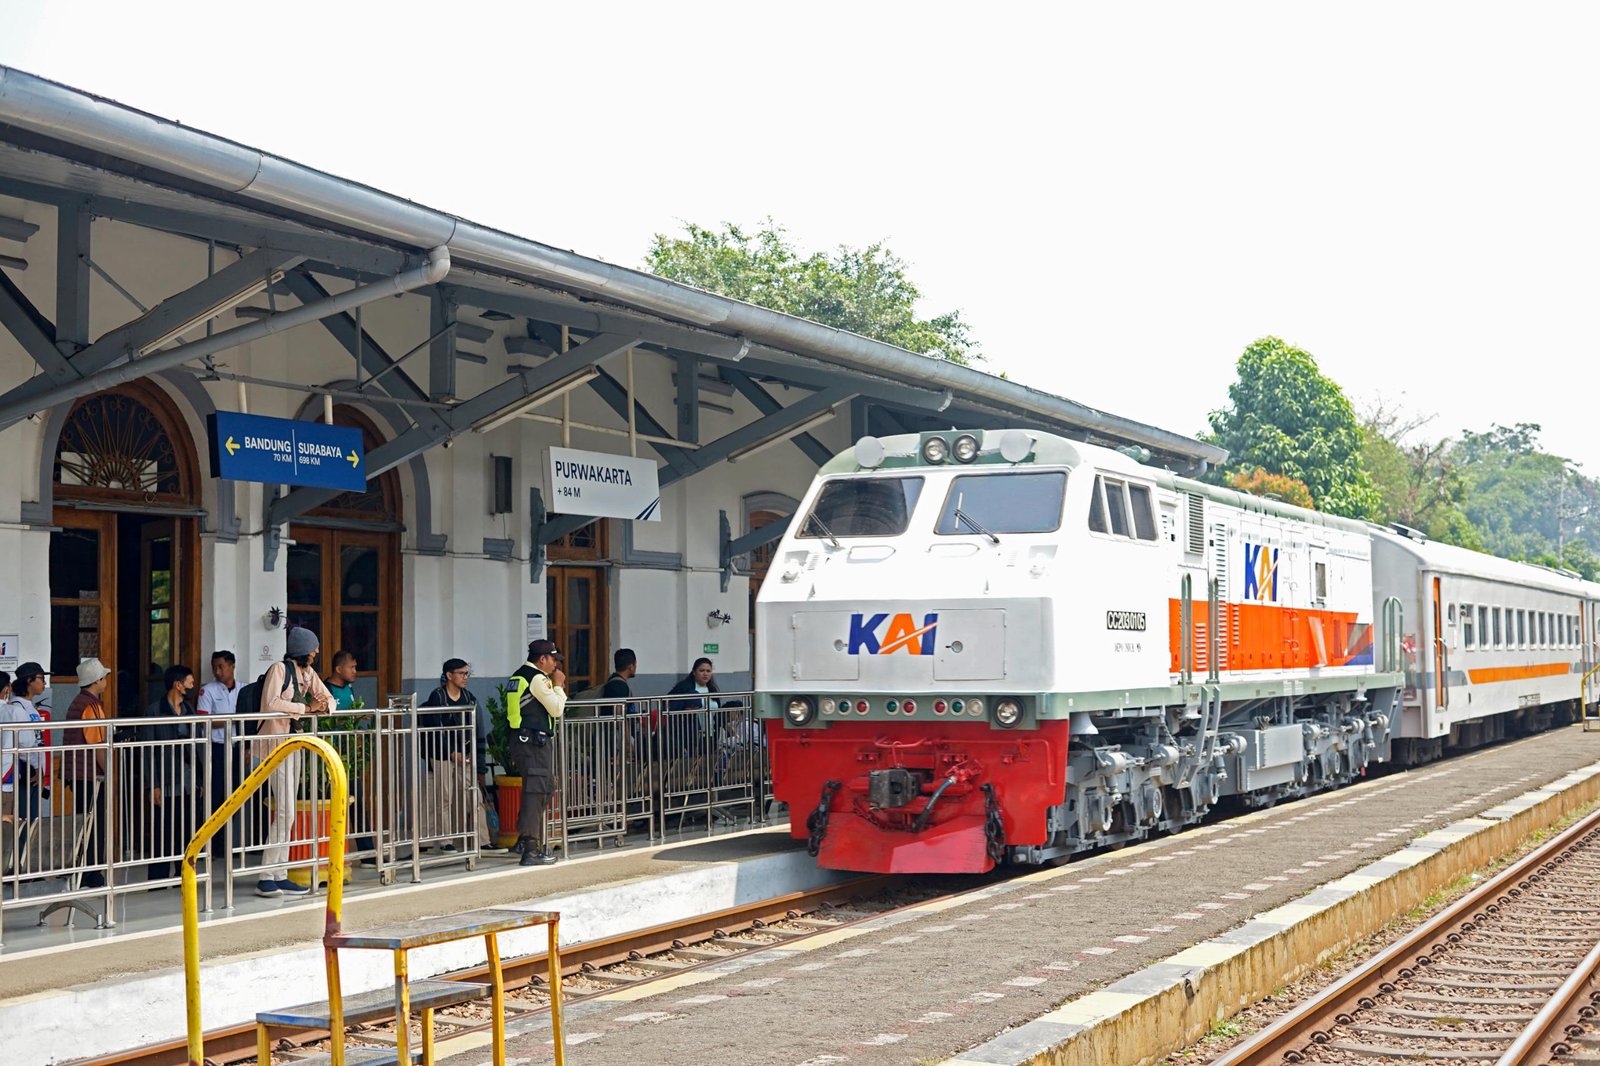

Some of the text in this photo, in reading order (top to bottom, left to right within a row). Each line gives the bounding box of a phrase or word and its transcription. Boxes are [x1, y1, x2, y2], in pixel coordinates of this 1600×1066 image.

[244, 436, 292, 453] BANDUNG
[298, 442, 342, 458] SURABAYA
[273, 453, 292, 463] 70 KM
[310, 457, 321, 466] KM
[555, 460, 632, 486] PURWAKARTA
[563, 486, 572, 497] 84
[573, 487, 581, 498] M
[1244, 542, 1279, 602] KAI
[847, 613, 939, 655] KAI
